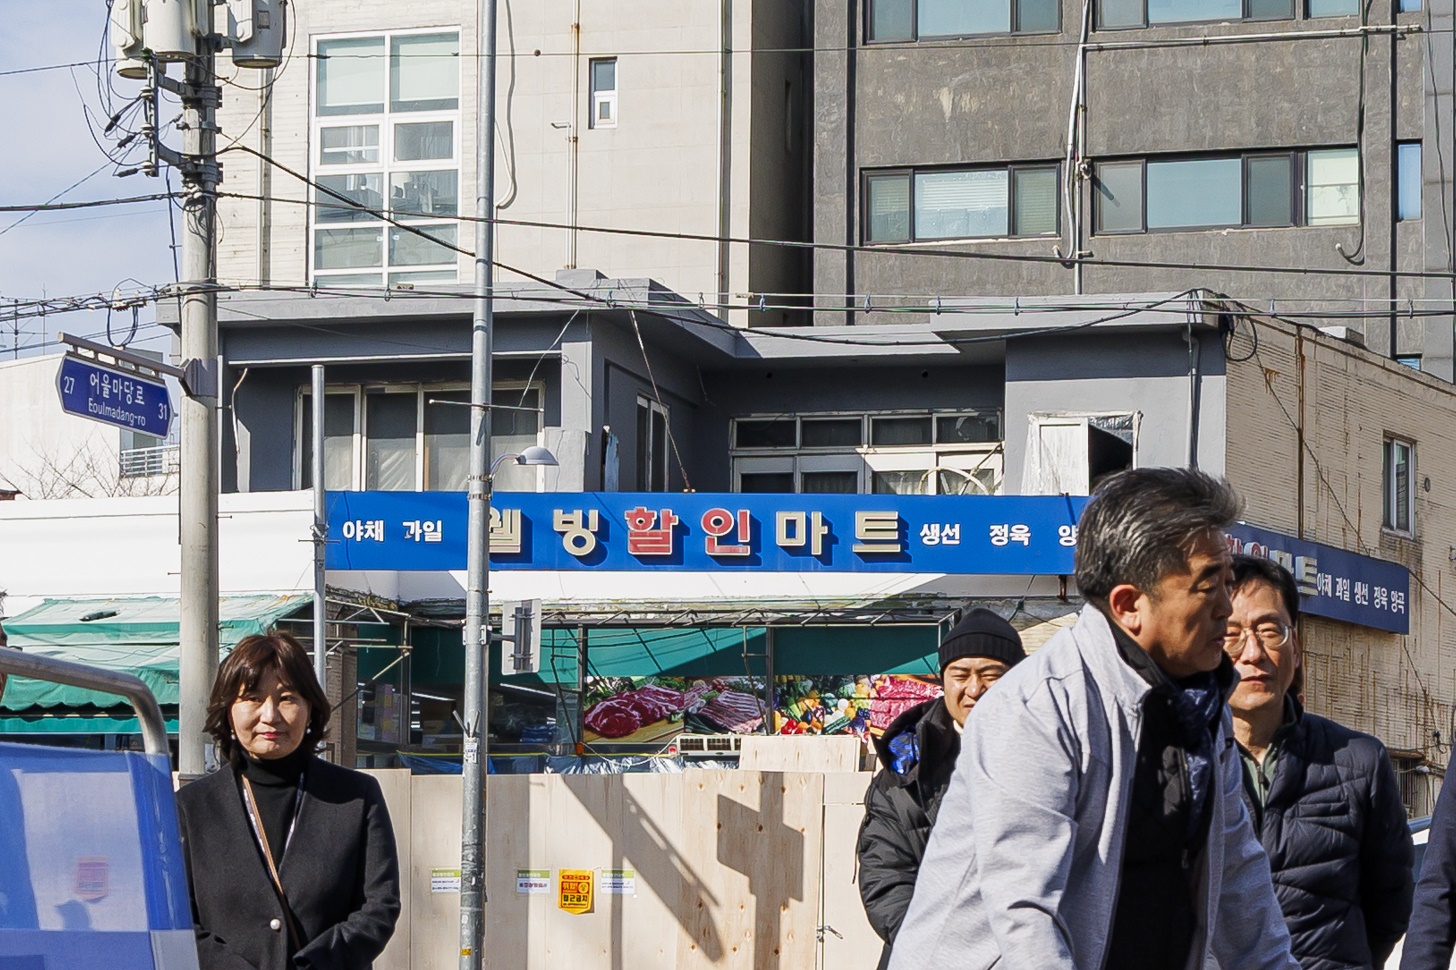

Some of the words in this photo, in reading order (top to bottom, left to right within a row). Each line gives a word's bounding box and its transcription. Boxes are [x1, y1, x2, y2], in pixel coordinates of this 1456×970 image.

[63, 375, 75, 395] 27
[89, 371, 145, 405] 어울마당로
[88, 397, 146, 427] Eoulmadang-ro
[157, 402, 168, 421] 31
[342, 519, 385, 542] 야채
[402, 519, 443, 542] 과일
[919, 523, 961, 546] 생선
[989, 523, 1031, 546] 정육
[1316, 572, 1333, 598] 야채
[1335, 576, 1351, 602] 과일
[1354, 581, 1369, 606] 생선
[1373, 586, 1388, 611] 정육
[1390, 590, 1405, 615] 양곡
